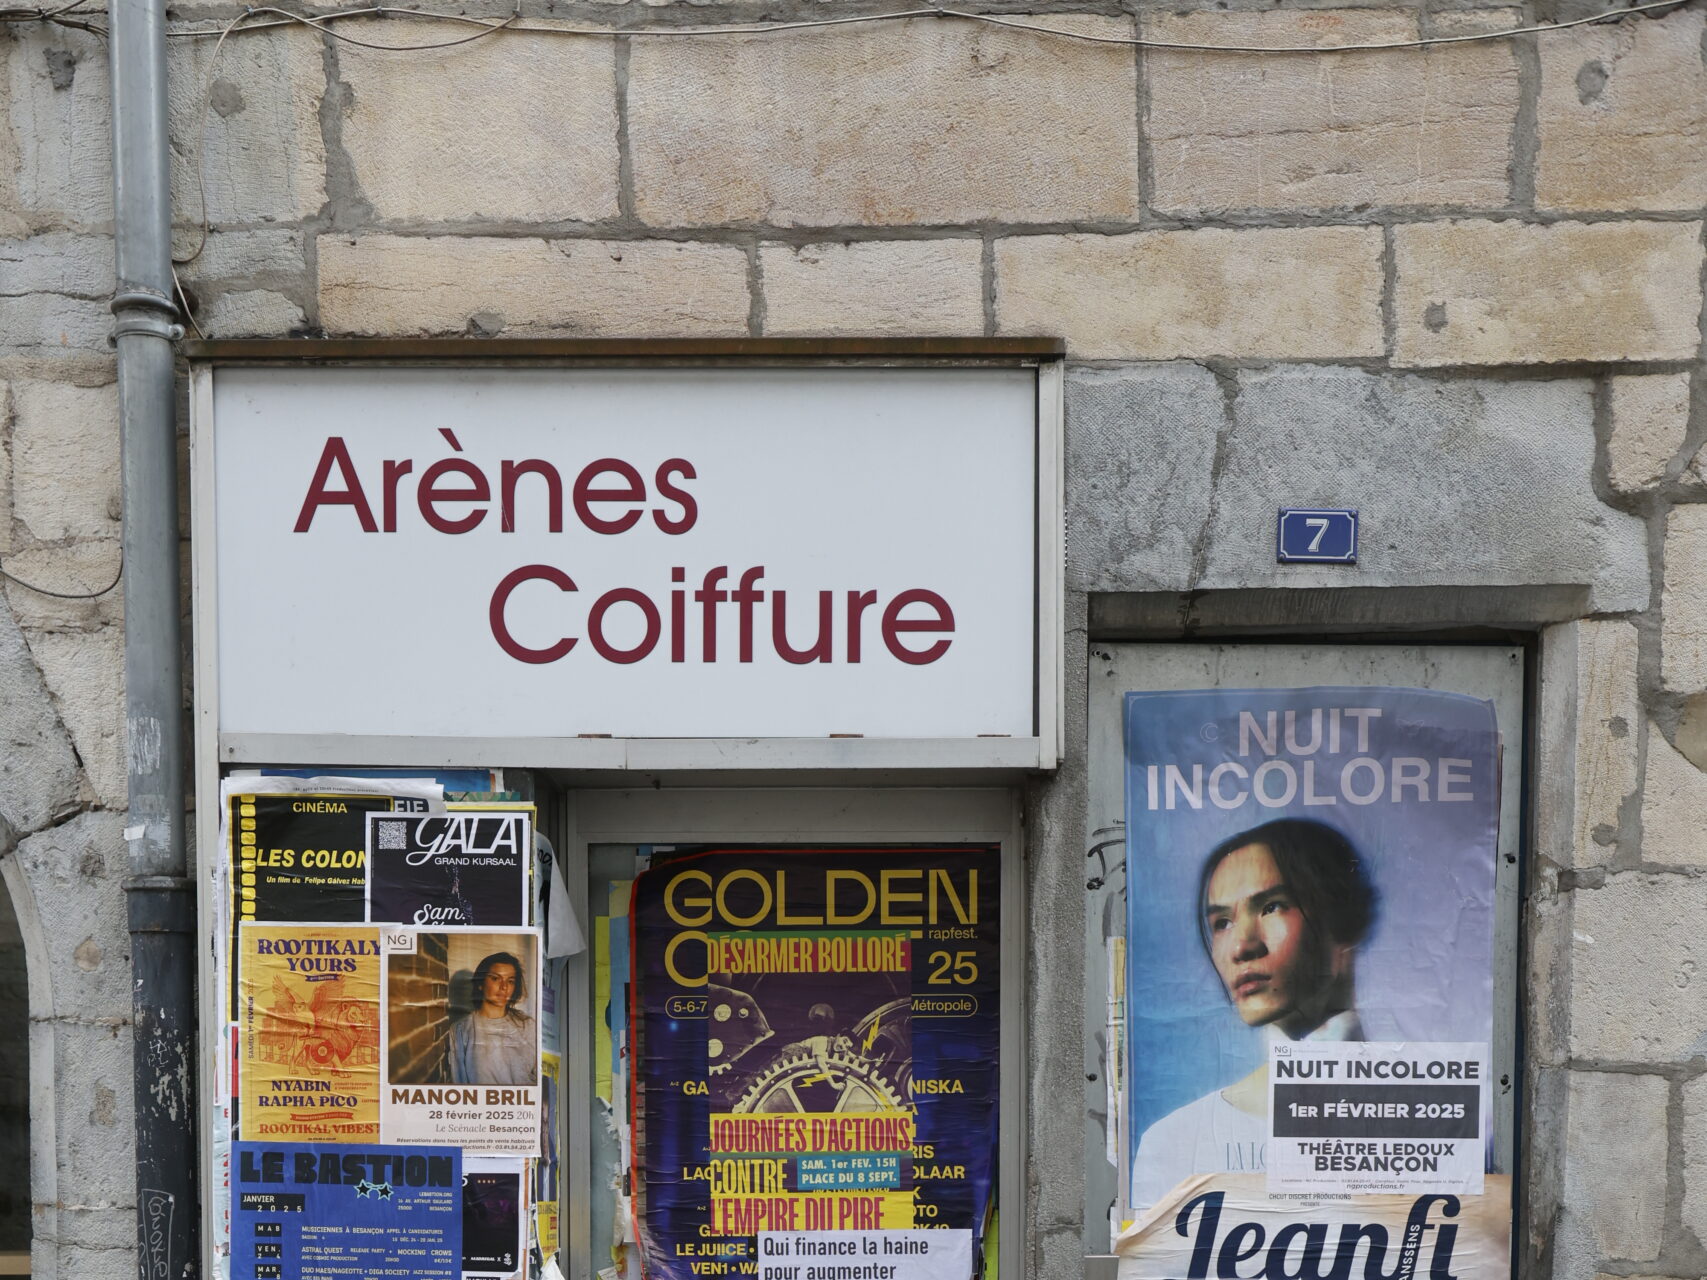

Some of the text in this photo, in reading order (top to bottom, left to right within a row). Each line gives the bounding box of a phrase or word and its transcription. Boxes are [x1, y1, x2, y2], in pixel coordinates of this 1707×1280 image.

[293, 428, 699, 535] Arènes
[1305, 518, 1330, 552] 7
[489, 564, 956, 665] Coiffure
[1238, 707, 1382, 757] NUIT
[1146, 756, 1474, 811] INCOLORE
[292, 800, 348, 814] CINÉMA
[405, 817, 517, 866] GALA
[256, 848, 295, 868] LES
[434, 857, 517, 866] GRAND KURSAAL
[663, 869, 978, 927] GOLDEN
[413, 903, 466, 926] Sam.
[387, 934, 407, 946] NG
[929, 929, 978, 941] rapfest.
[708, 932, 906, 974] DÉSARMER BOLLORÉ
[286, 957, 357, 972] YOURS
[927, 950, 978, 985] 25
[673, 1000, 707, 1013] 5-6-7
[1274, 1046, 1288, 1054] NG
[1276, 1060, 1479, 1080] NUIT INCOLORE
[271, 1080, 331, 1092] NYABIN
[258, 1095, 316, 1107] RAPHA
[320, 1095, 358, 1107] PICO
[391, 1088, 536, 1106] MANON BRIL
[429, 1110, 534, 1120] 28 février 2025 20h
[1288, 1099, 1465, 1119] 1ER FÉVRIER 2025
[259, 1123, 374, 1134] ROOTIKAL VIBES
[435, 1124, 536, 1135] Le Scénacle Besançon
[709, 1115, 910, 1153] JOURNÉES D'ACTIONS
[1297, 1139, 1455, 1156] THÉÂTRE LEDOUX
[240, 1151, 453, 1188] LE BASTION
[802, 1157, 896, 1170] SAM. 1er FEV. 15H
[1314, 1155, 1438, 1175] BESANÇON
[710, 1158, 788, 1194] CONTRE
[802, 1171, 897, 1184] PLACE DU 8 SEPT.
[242, 1195, 275, 1203] JANVIER
[710, 1196, 885, 1235] L'EMPIRE DU PIRE
[676, 1243, 695, 1256] LE
[763, 1236, 930, 1259] Qui finance la haine
[690, 1262, 728, 1275] VEN1
